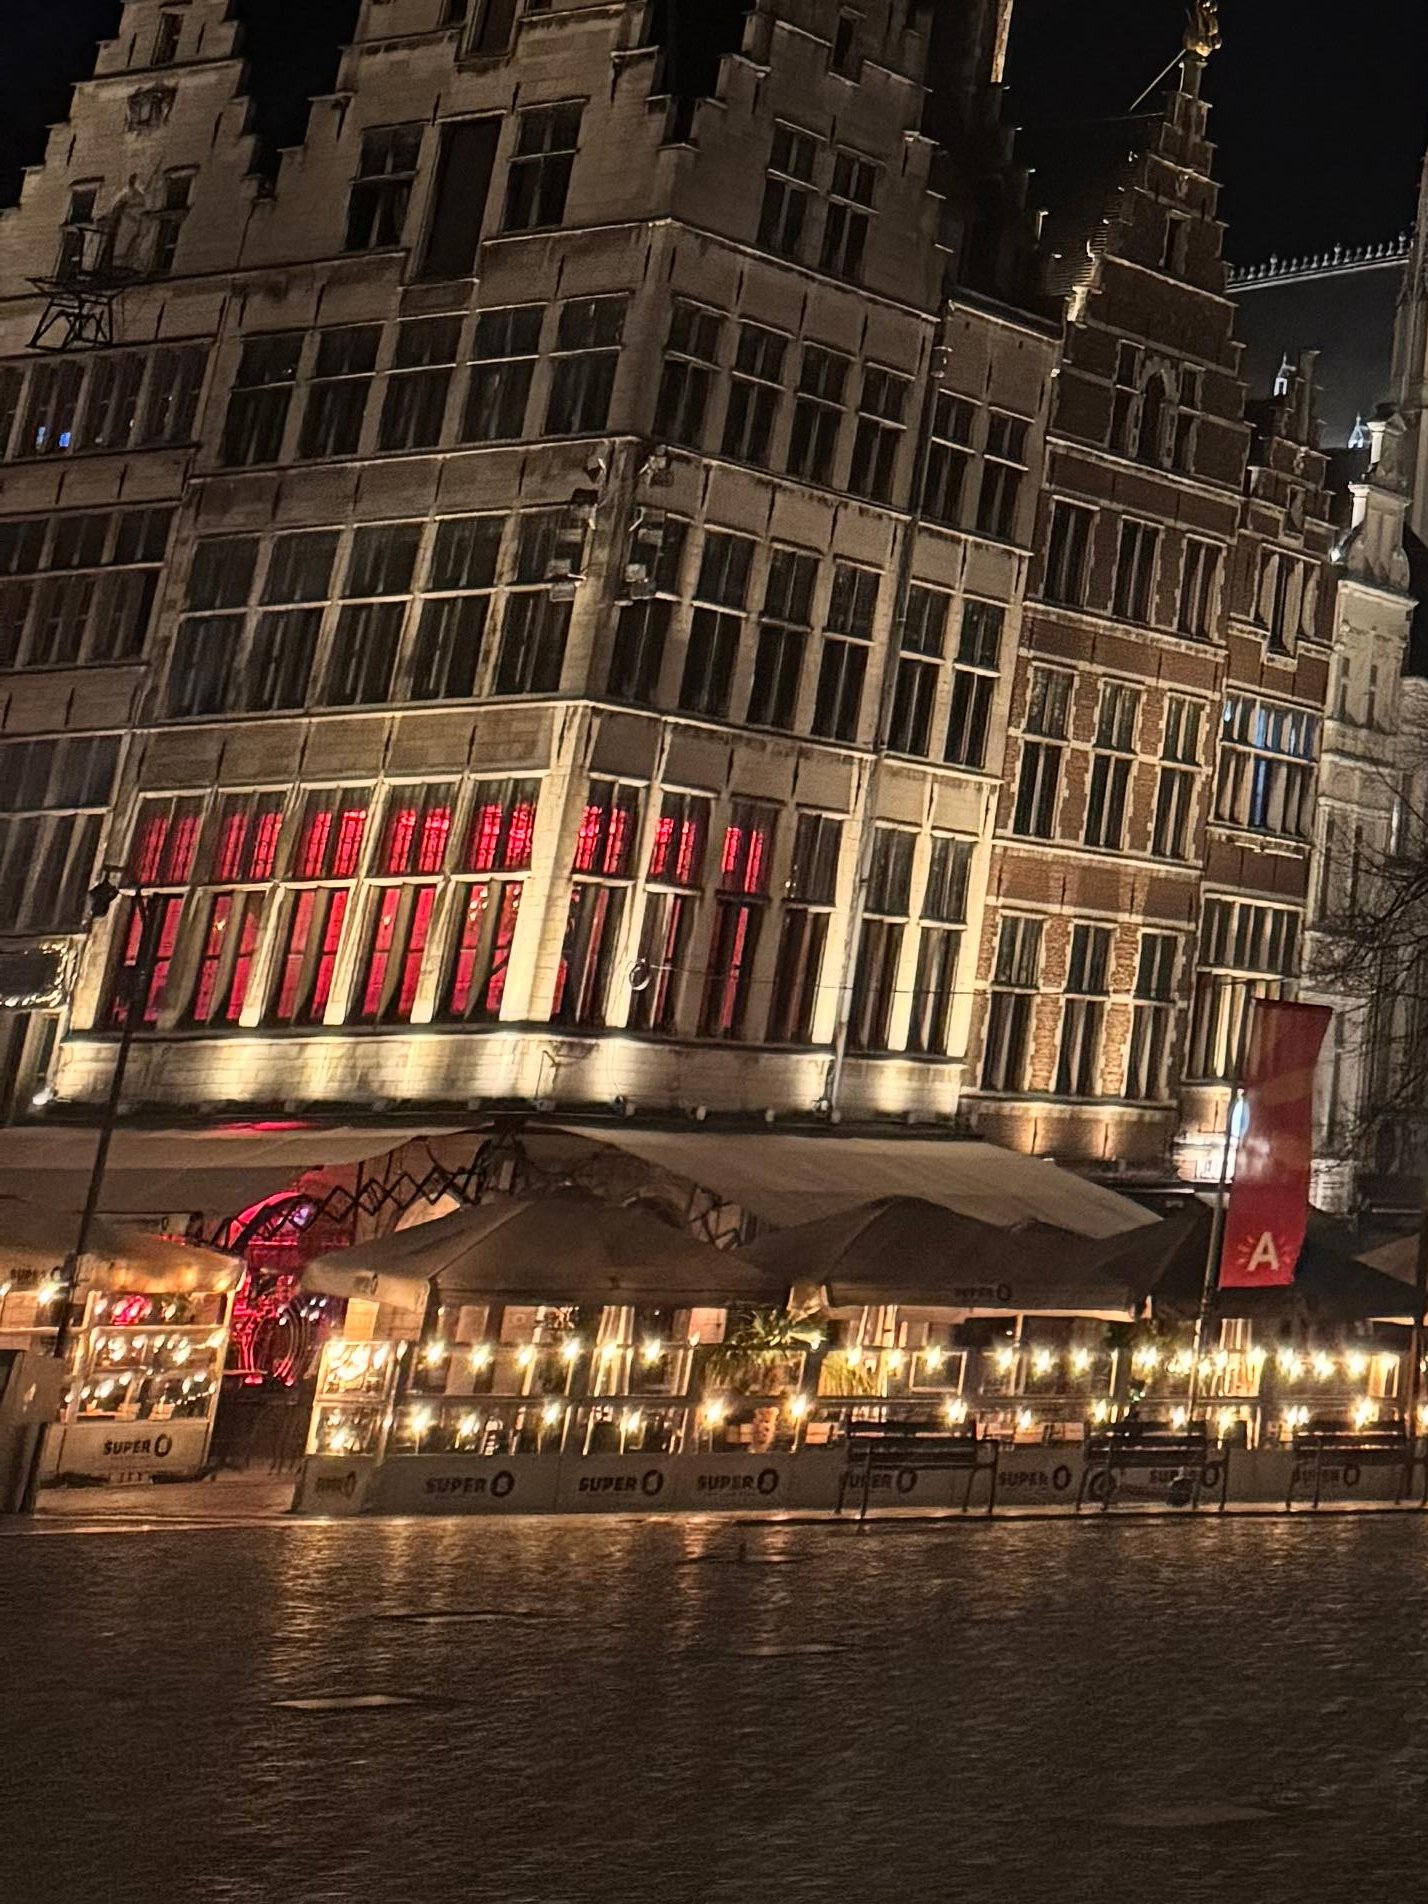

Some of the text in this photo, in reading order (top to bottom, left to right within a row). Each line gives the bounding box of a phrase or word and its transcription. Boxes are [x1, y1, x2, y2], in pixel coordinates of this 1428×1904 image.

[1247, 1231, 1280, 1272] A
[103, 1440, 151, 1457] SUPER
[425, 1476, 489, 1493] SUPER
[578, 1476, 638, 1492] SUPER
[697, 1474, 755, 1491] SUPER
